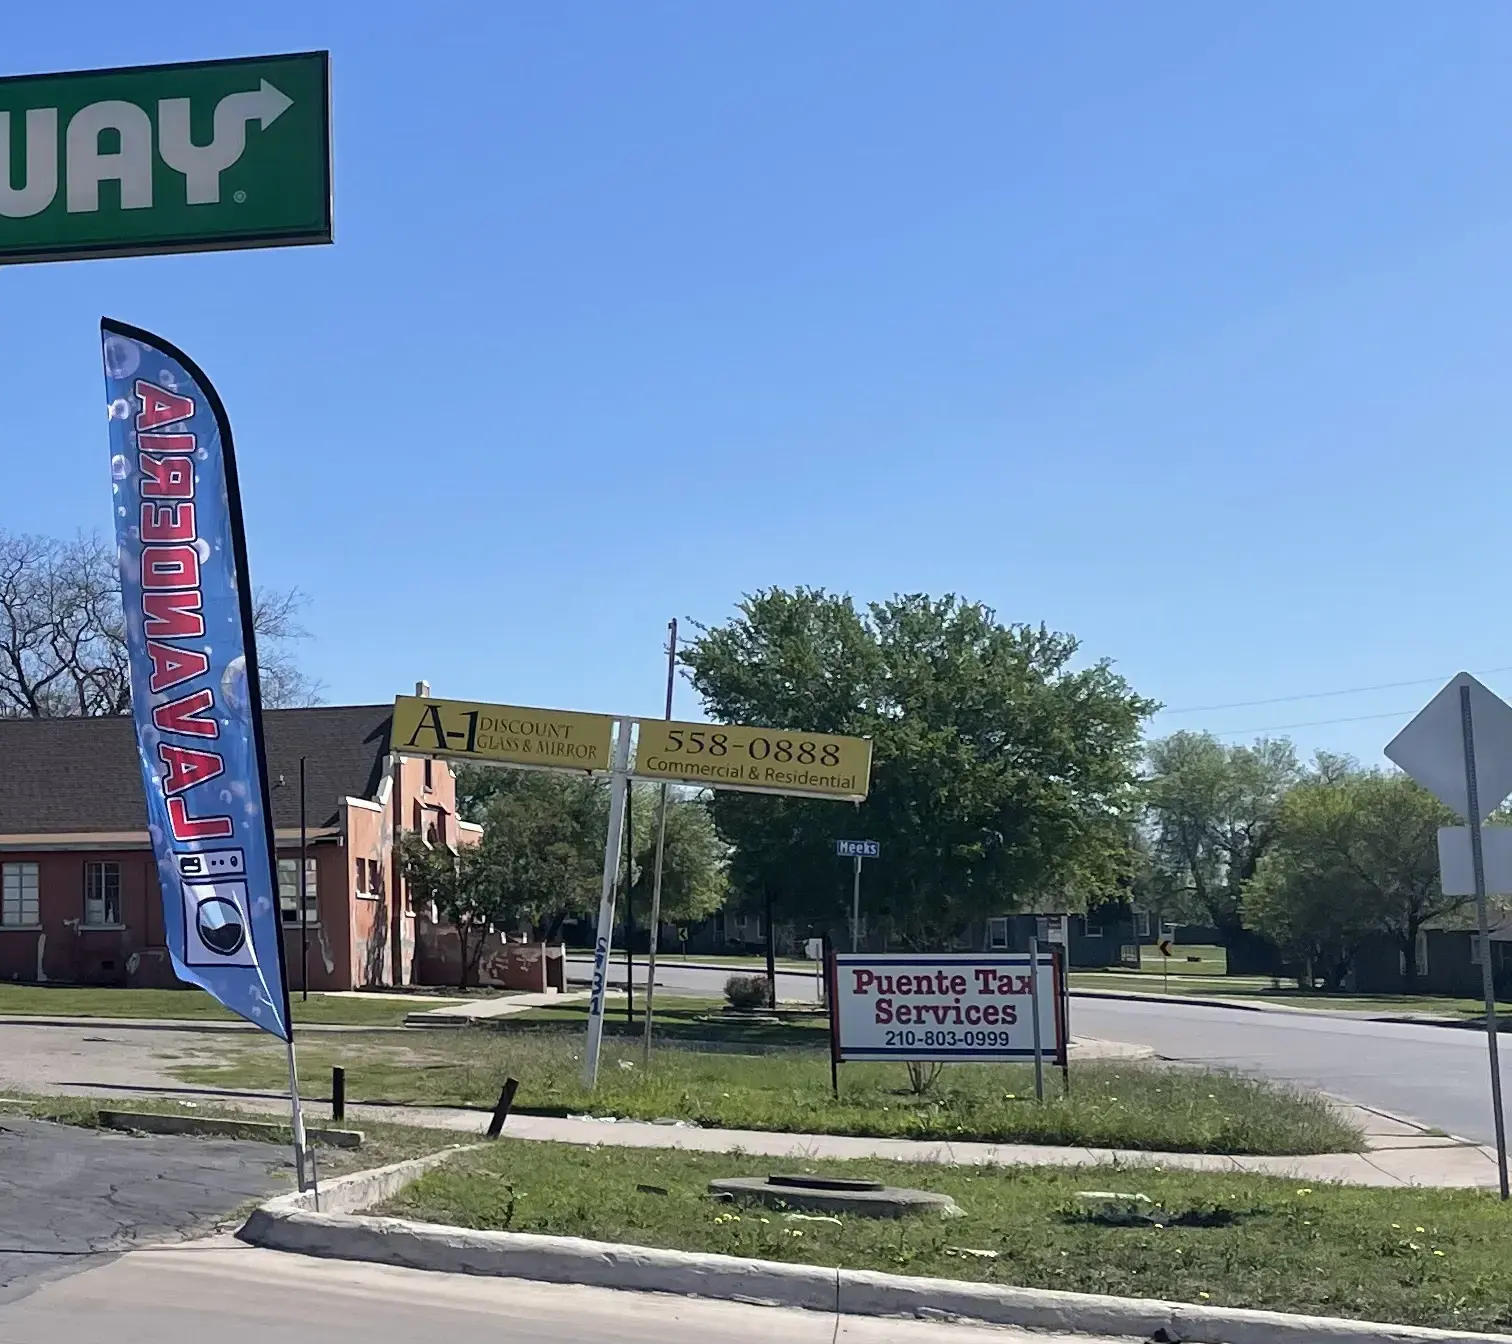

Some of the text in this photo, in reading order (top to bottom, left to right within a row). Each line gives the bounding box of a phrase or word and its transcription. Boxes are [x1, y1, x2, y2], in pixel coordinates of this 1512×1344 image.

[402, 704, 575, 754] A-1 DISCOUNT
[476, 734, 597, 760] GLASS & MIRROR
[664, 730, 840, 767] 558-0888
[646, 756, 856, 790] Commercial & Residential
[840, 841, 877, 855] Meeks
[852, 969, 1033, 995] Puente Tax
[875, 998, 1017, 1026] Services
[885, 1030, 1010, 1047] 210-803-0999
